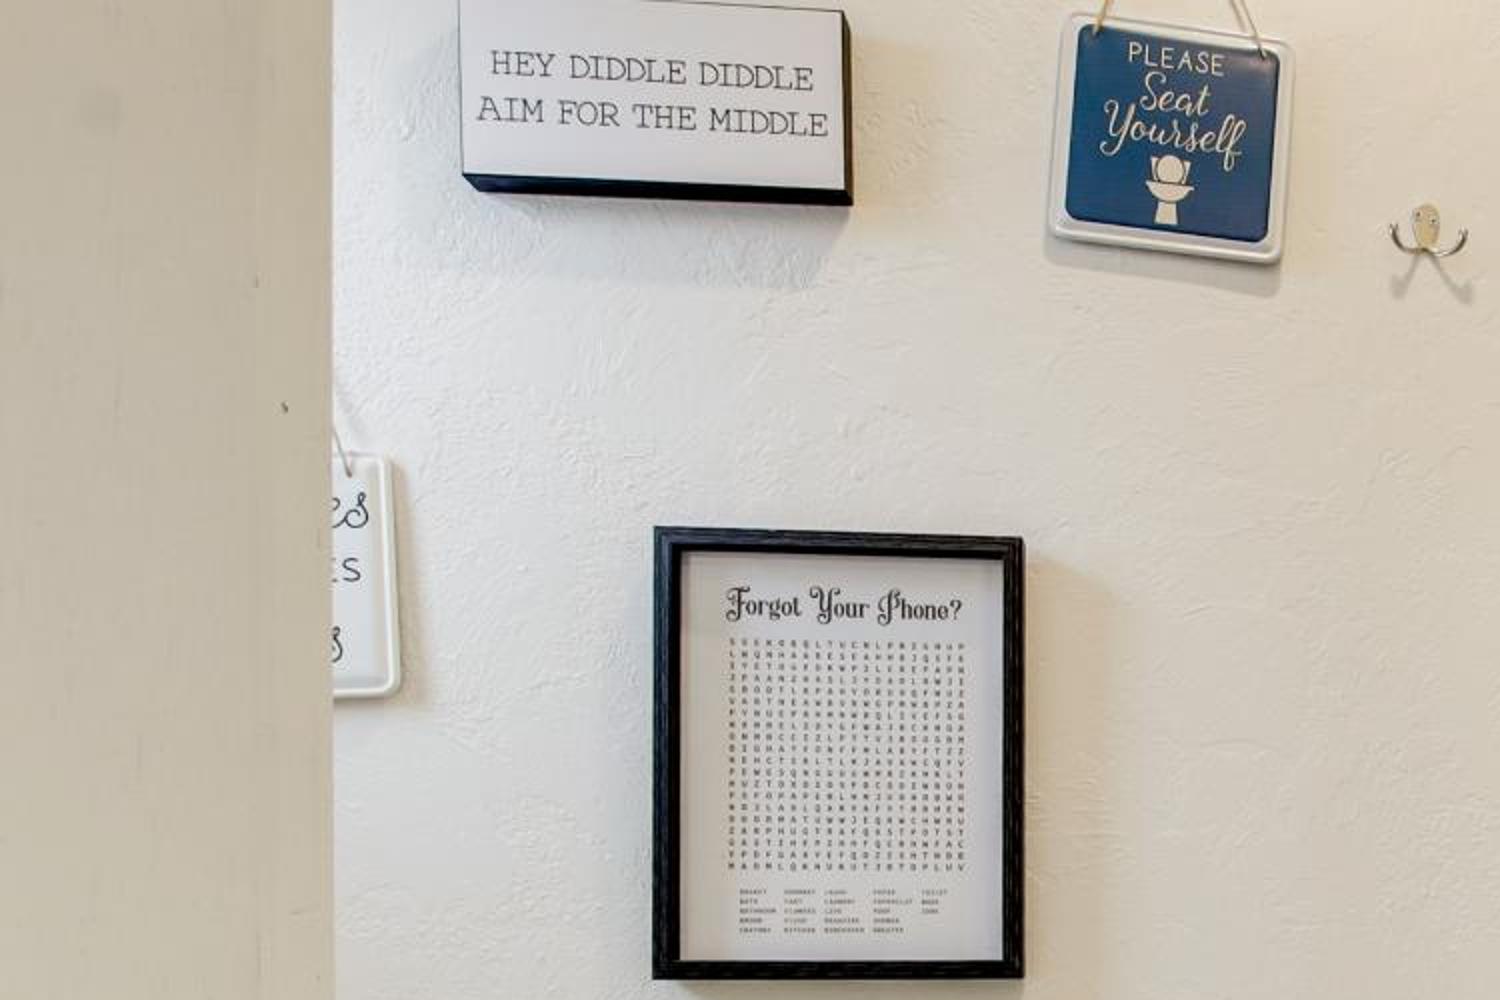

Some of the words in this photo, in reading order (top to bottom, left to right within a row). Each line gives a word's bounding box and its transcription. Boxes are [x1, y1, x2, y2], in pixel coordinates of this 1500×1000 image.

[491, 50, 555, 78] HEY
[569, 54, 687, 86] DIDDLE
[698, 61, 814, 92] DIDDLE
[1128, 41, 1225, 77] PLEASE
[1140, 71, 1211, 117] Seat
[476, 96, 543, 123] AIM
[559, 100, 620, 128] FOR
[632, 104, 697, 131] THE
[709, 107, 829, 137] MIDDLE
[1099, 100, 1247, 172] Yourself
[725, 586, 803, 623] Forgot
[809, 585, 869, 625] Your
[877, 588, 963, 627] Phone?
